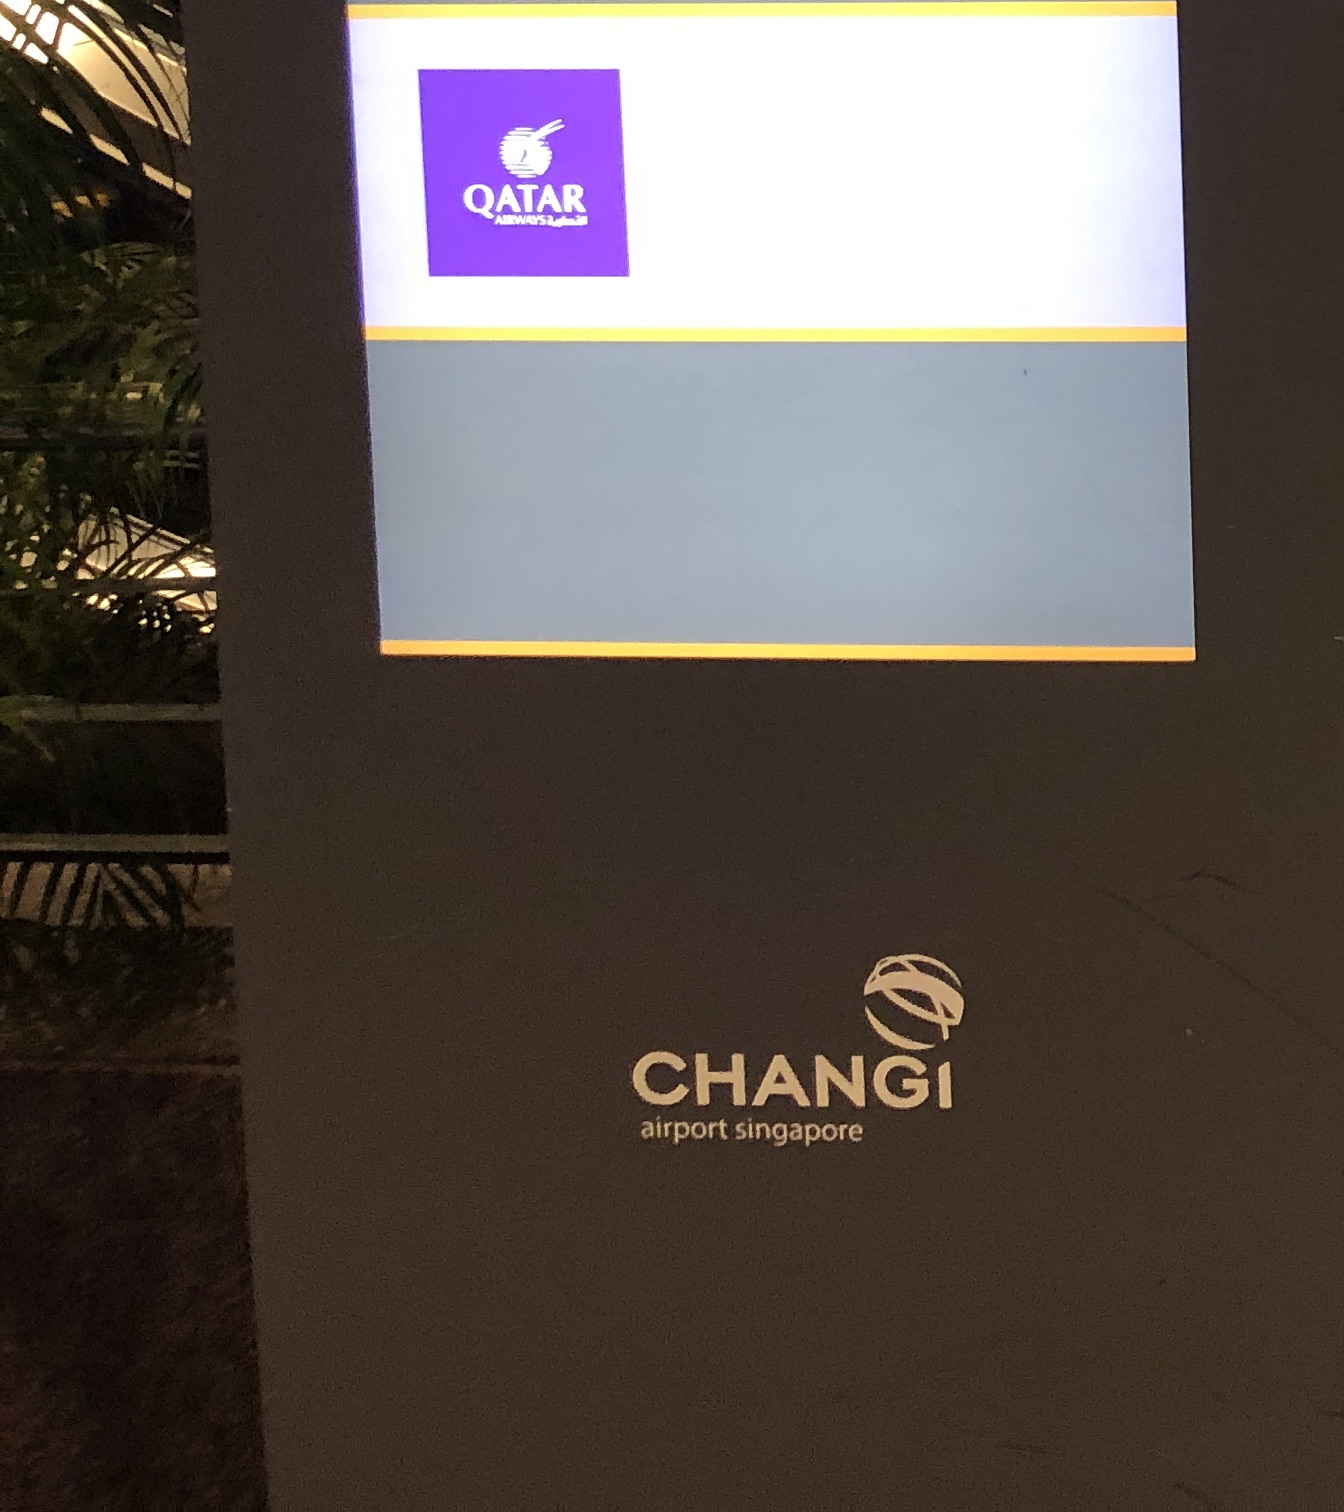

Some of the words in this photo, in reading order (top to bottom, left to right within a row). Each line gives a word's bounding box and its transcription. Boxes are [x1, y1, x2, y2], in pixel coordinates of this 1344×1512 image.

[463, 184, 588, 220] QATAR
[631, 1049, 953, 1110] CHANGI
[640, 1115, 728, 1144] airport
[735, 1117, 865, 1147] singapore
